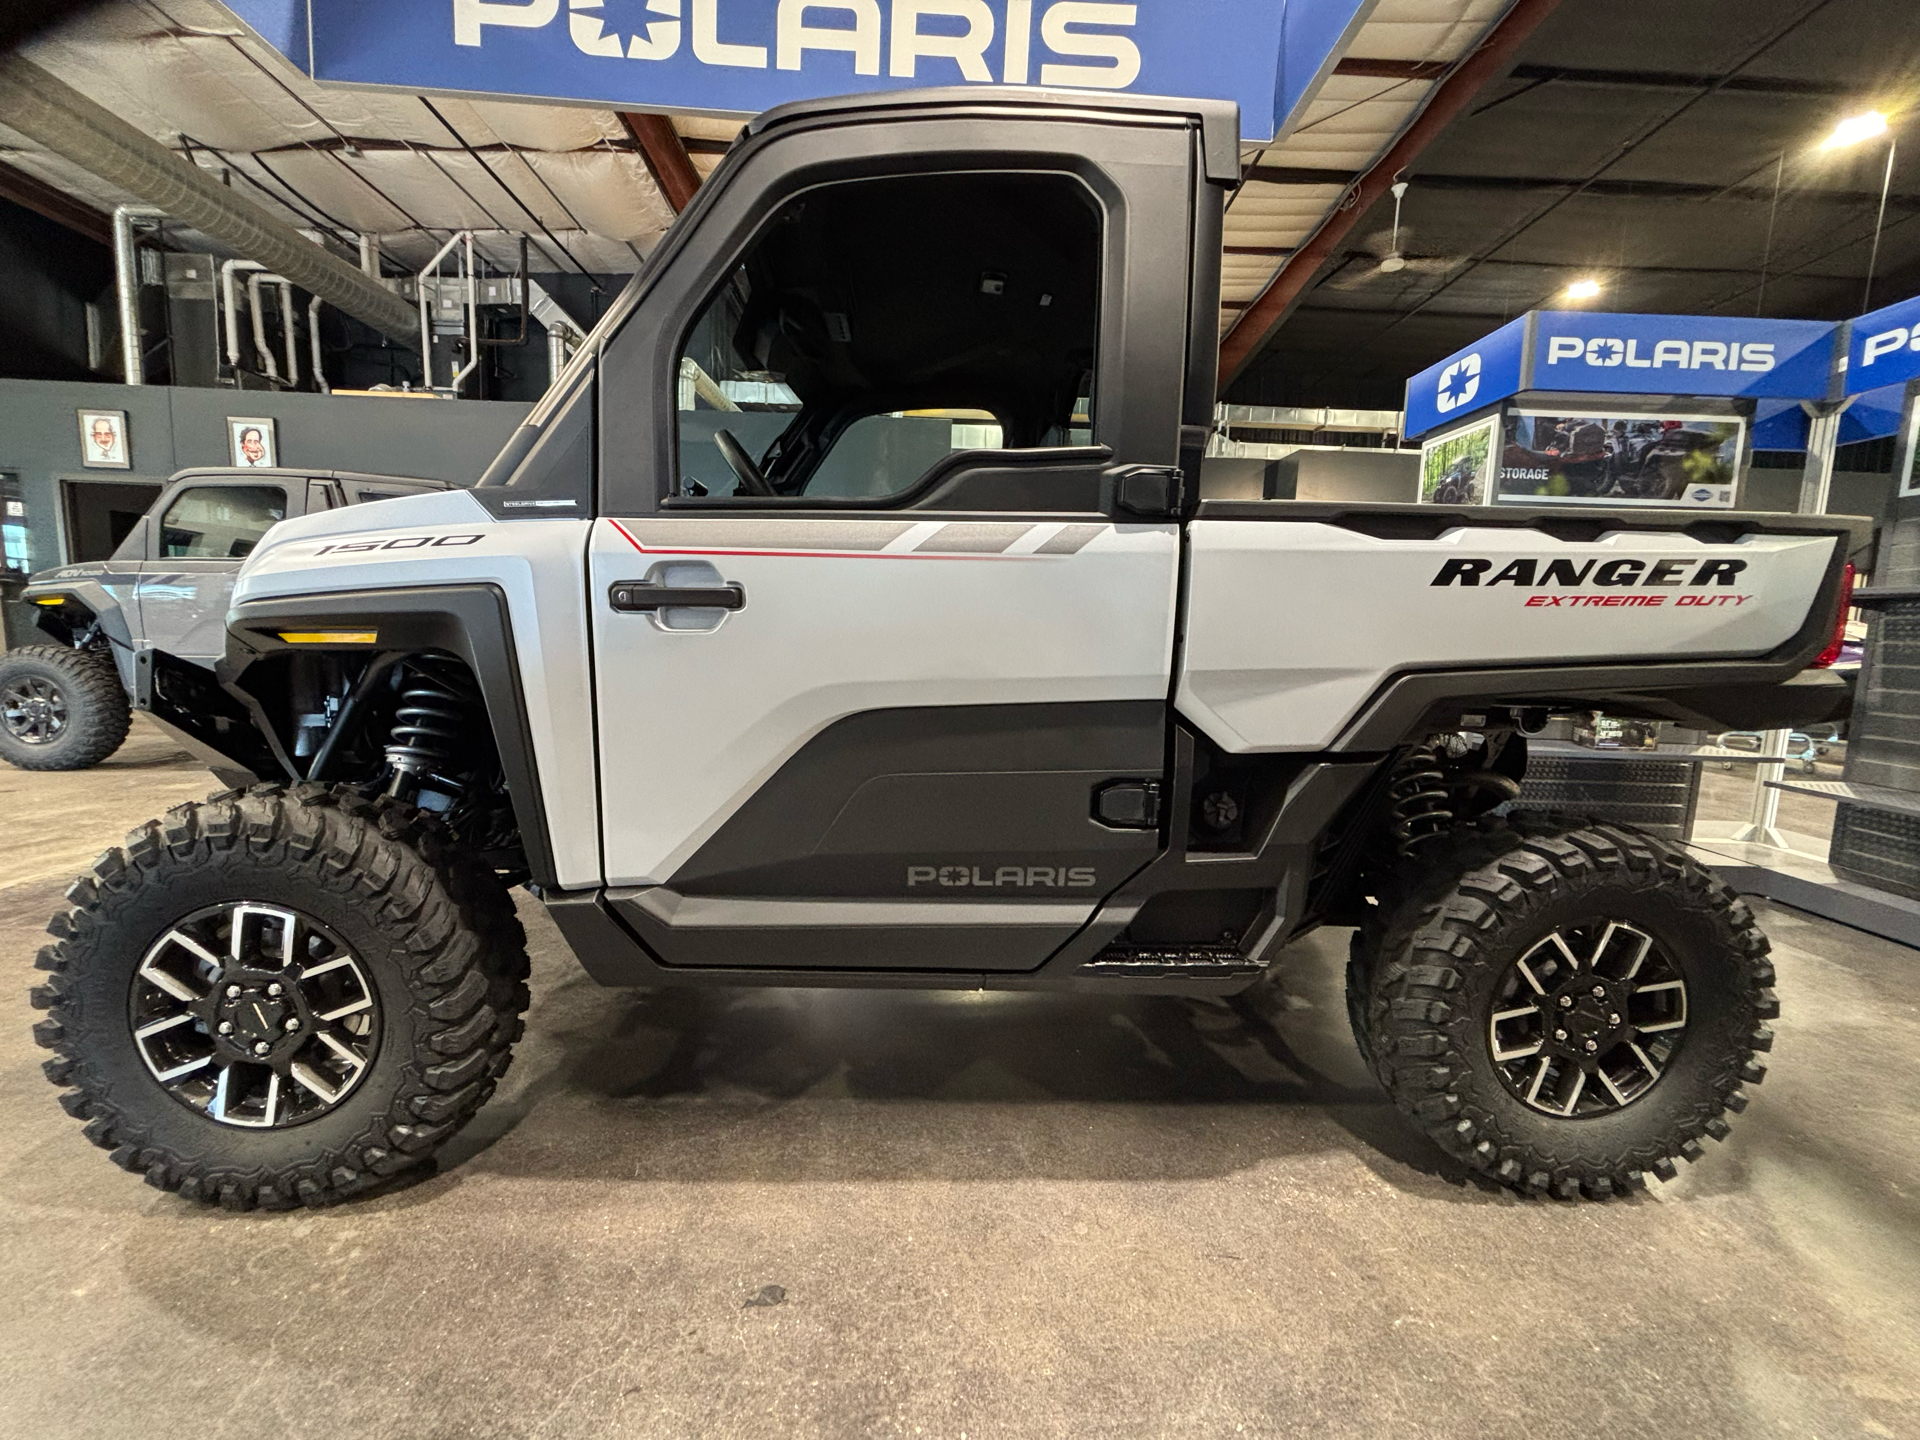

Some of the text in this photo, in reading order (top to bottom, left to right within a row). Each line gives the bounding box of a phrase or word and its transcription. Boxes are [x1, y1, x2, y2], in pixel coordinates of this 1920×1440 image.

[1547, 336, 1776, 372] POLARIS
[1500, 467, 1549, 480] STORAGE
[314, 534, 486, 557] 1500
[1430, 558, 1748, 586] RANGER
[1524, 595, 1754, 607] EXTREME DUTY
[907, 866, 1096, 887] POLARIS
